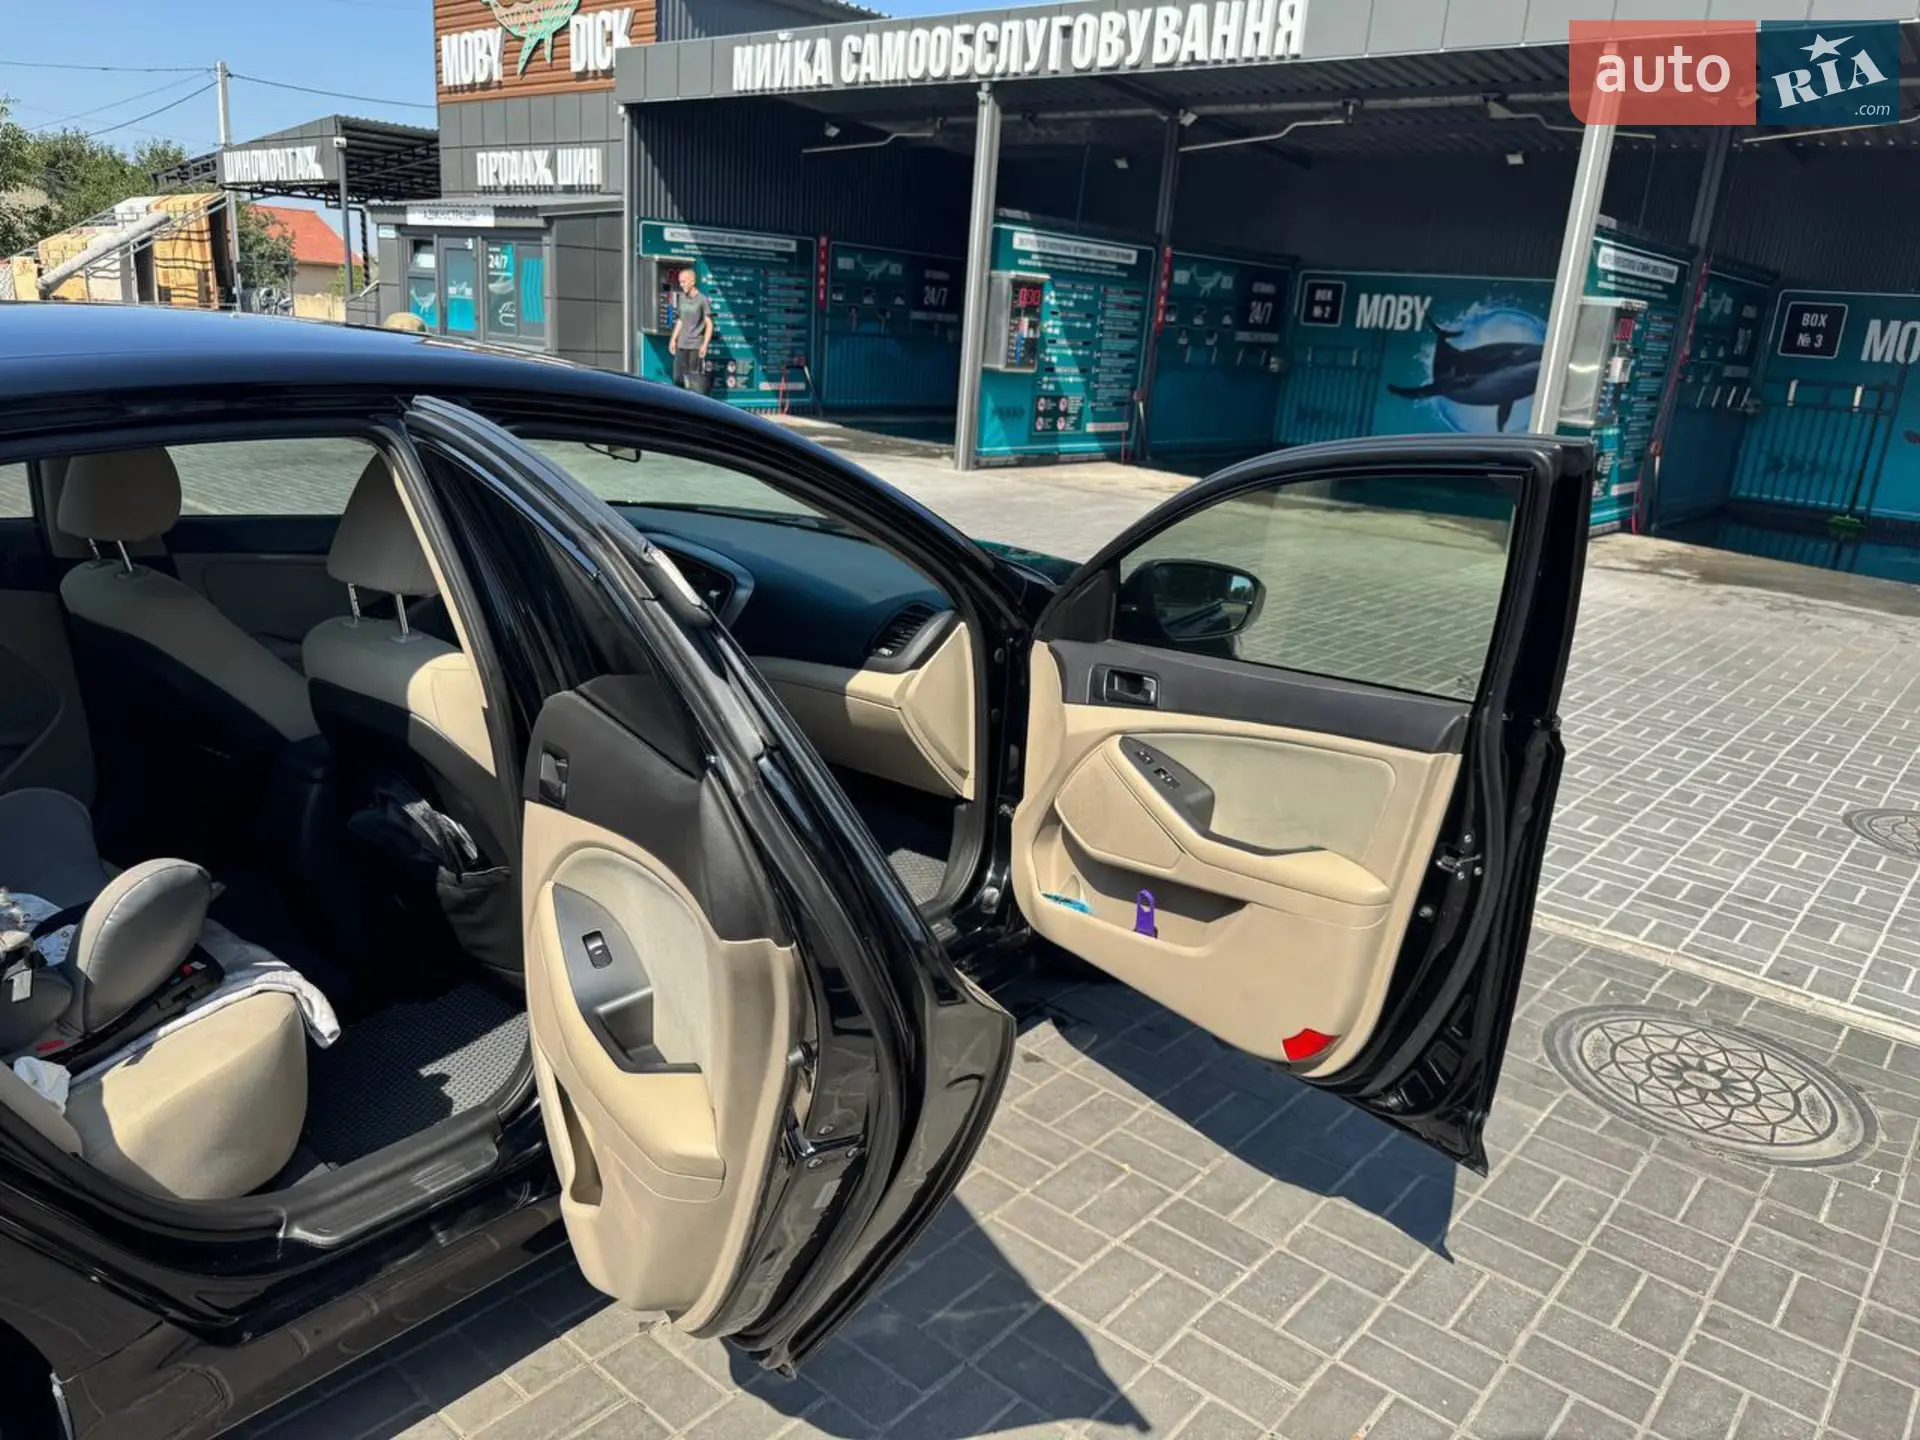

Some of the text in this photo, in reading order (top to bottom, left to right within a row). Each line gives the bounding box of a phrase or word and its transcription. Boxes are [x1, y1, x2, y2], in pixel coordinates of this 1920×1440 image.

[441, 7, 635, 86] MOBY DICK
[732, 0, 1307, 92] МИЙКА САМООБСЛУГОВУВАННЯ
[223, 145, 325, 184] ШИНОМОНТАЖ
[476, 147, 602, 187] ПРОДАЖ ШИН
[488, 254, 508, 270] 24/7
[1249, 301, 1273, 325] 24/7
[1355, 292, 1432, 333] MOBY
[1801, 312, 1828, 328] BOX
[1814, 334, 1824, 348] 3
